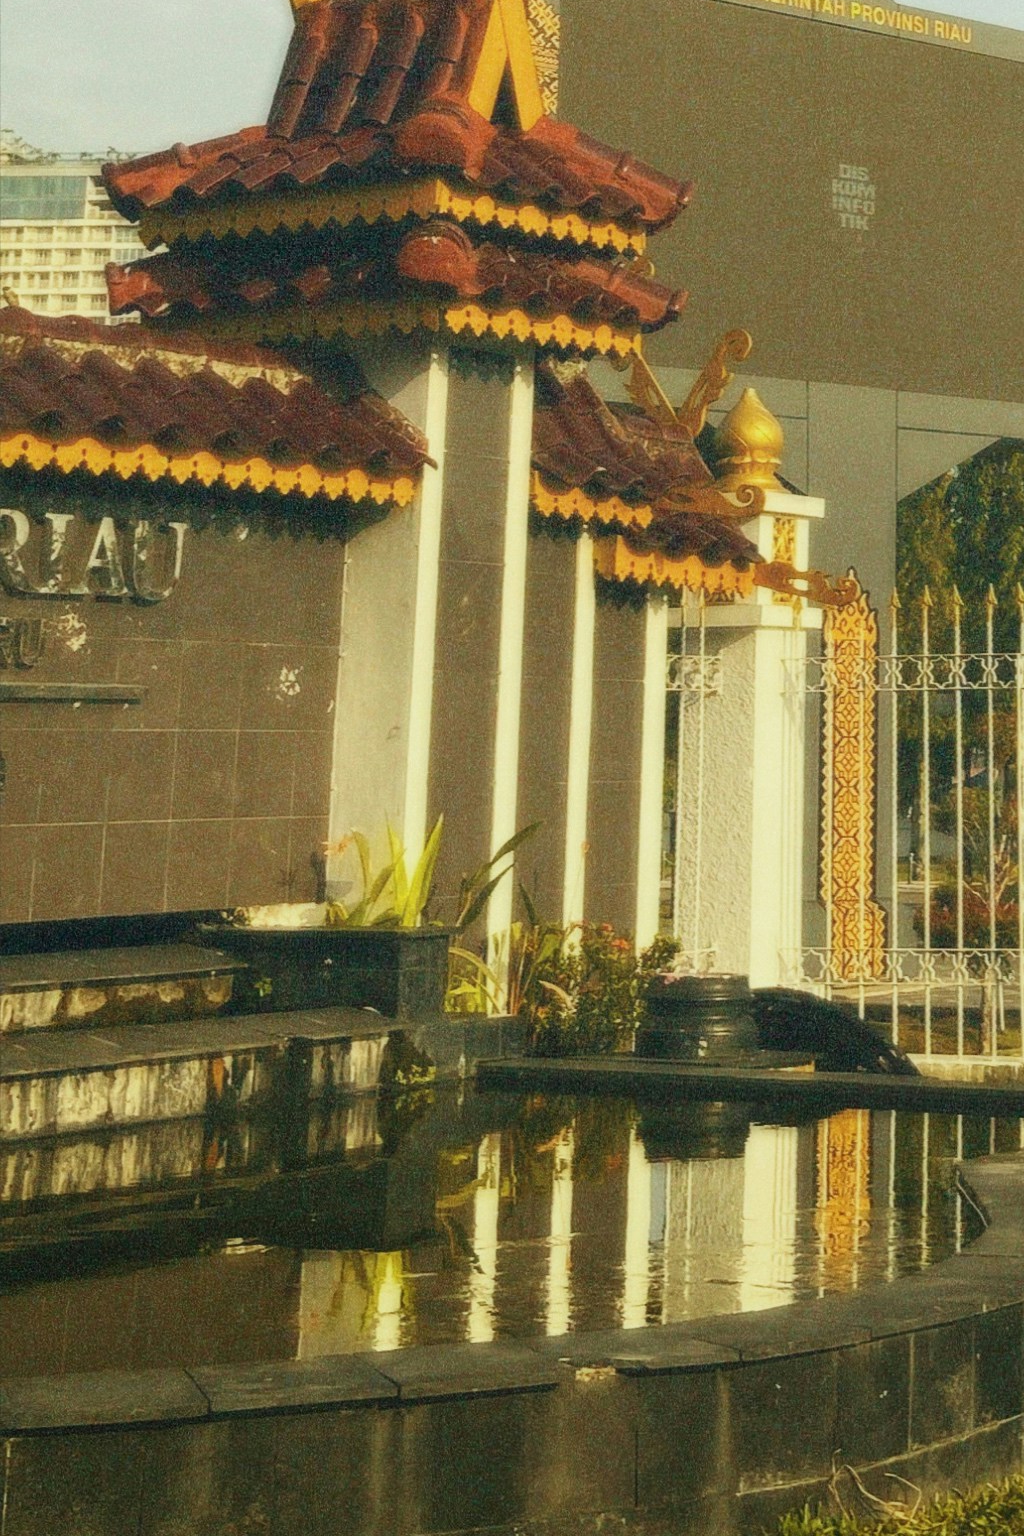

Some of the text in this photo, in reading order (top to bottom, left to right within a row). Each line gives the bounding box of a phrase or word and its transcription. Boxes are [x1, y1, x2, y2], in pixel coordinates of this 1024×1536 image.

[850, 1, 930, 36] PROVINSI
[934, 20, 973, 44] RIAU
[838, 163, 870, 181] DIS
[832, 195, 876, 215] INFO
